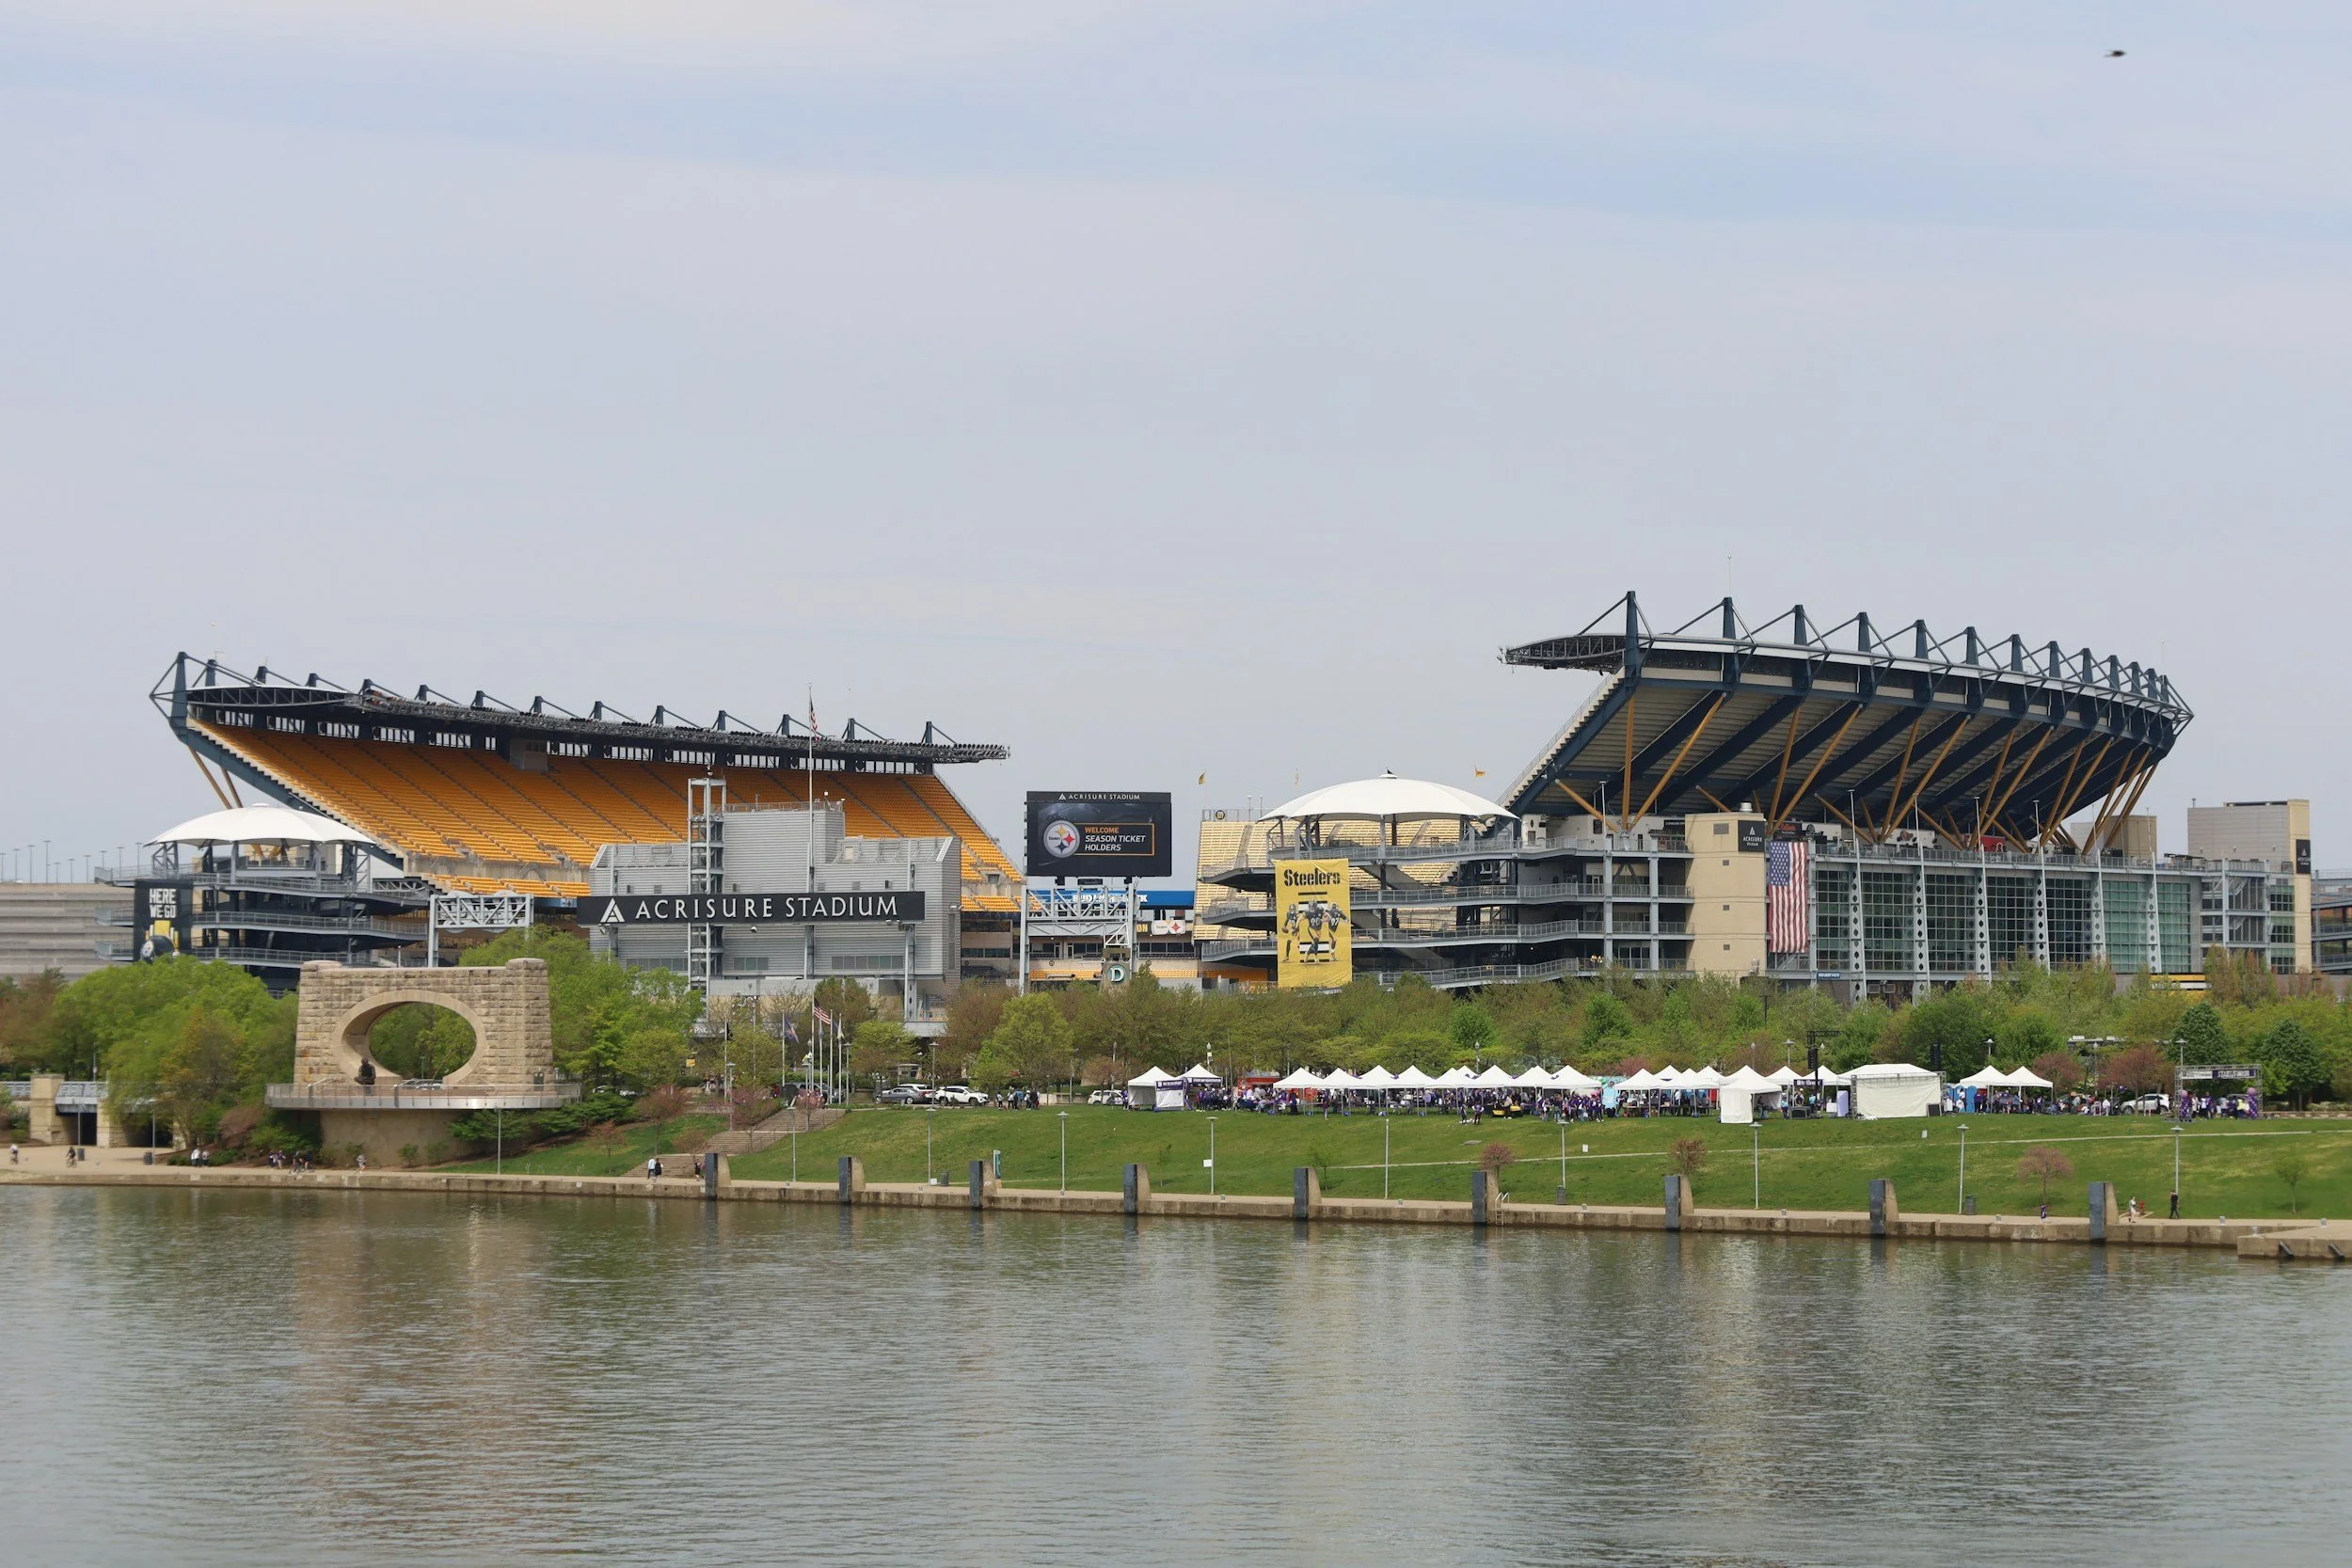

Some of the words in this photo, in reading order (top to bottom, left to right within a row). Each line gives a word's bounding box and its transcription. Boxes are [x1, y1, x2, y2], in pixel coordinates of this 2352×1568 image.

[1284, 867, 1341, 886] Steelers
[149, 888, 176, 904] HERE
[150, 904, 163, 918] WE
[635, 897, 772, 919] ACRISURE
[785, 895, 898, 918] STADIUM
[1111, 968, 1124, 982] D
